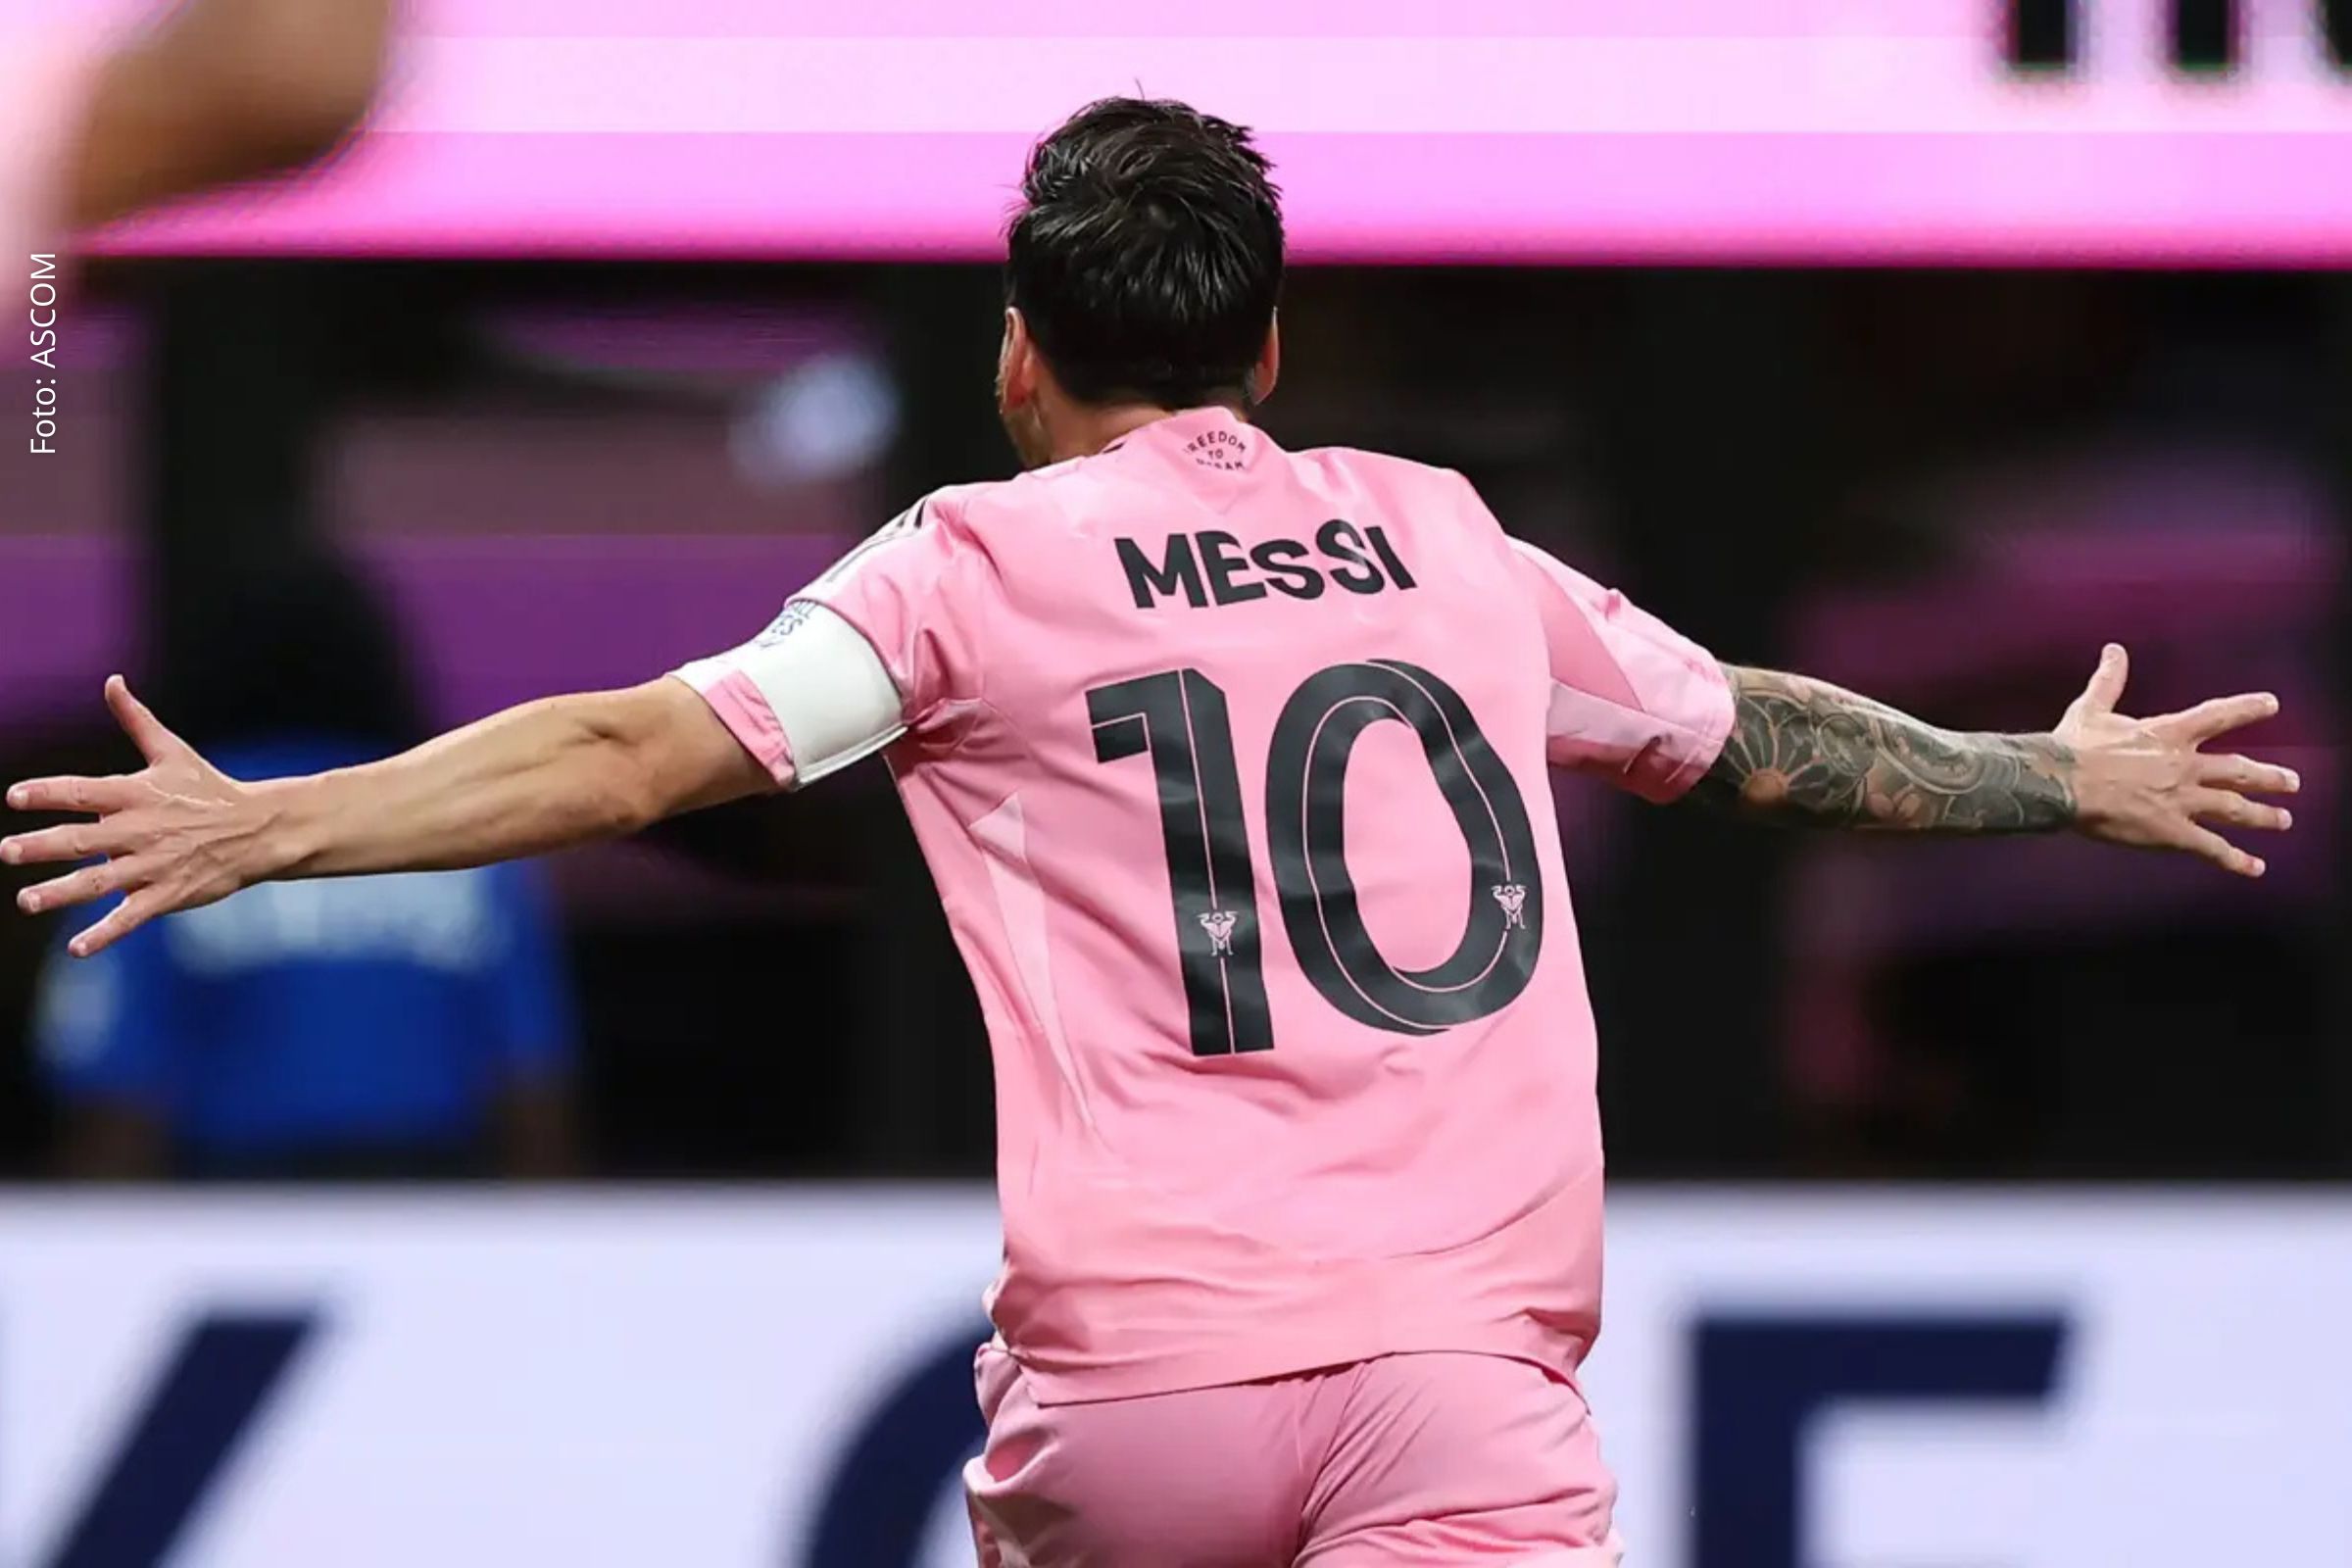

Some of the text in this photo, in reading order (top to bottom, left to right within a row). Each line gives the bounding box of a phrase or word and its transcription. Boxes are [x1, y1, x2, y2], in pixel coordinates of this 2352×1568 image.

[1182, 430, 1247, 454] REEDOM
[1207, 448, 1224, 460] TO
[1114, 518, 1417, 609] MESSI
[1085, 660, 1544, 1056] 10
